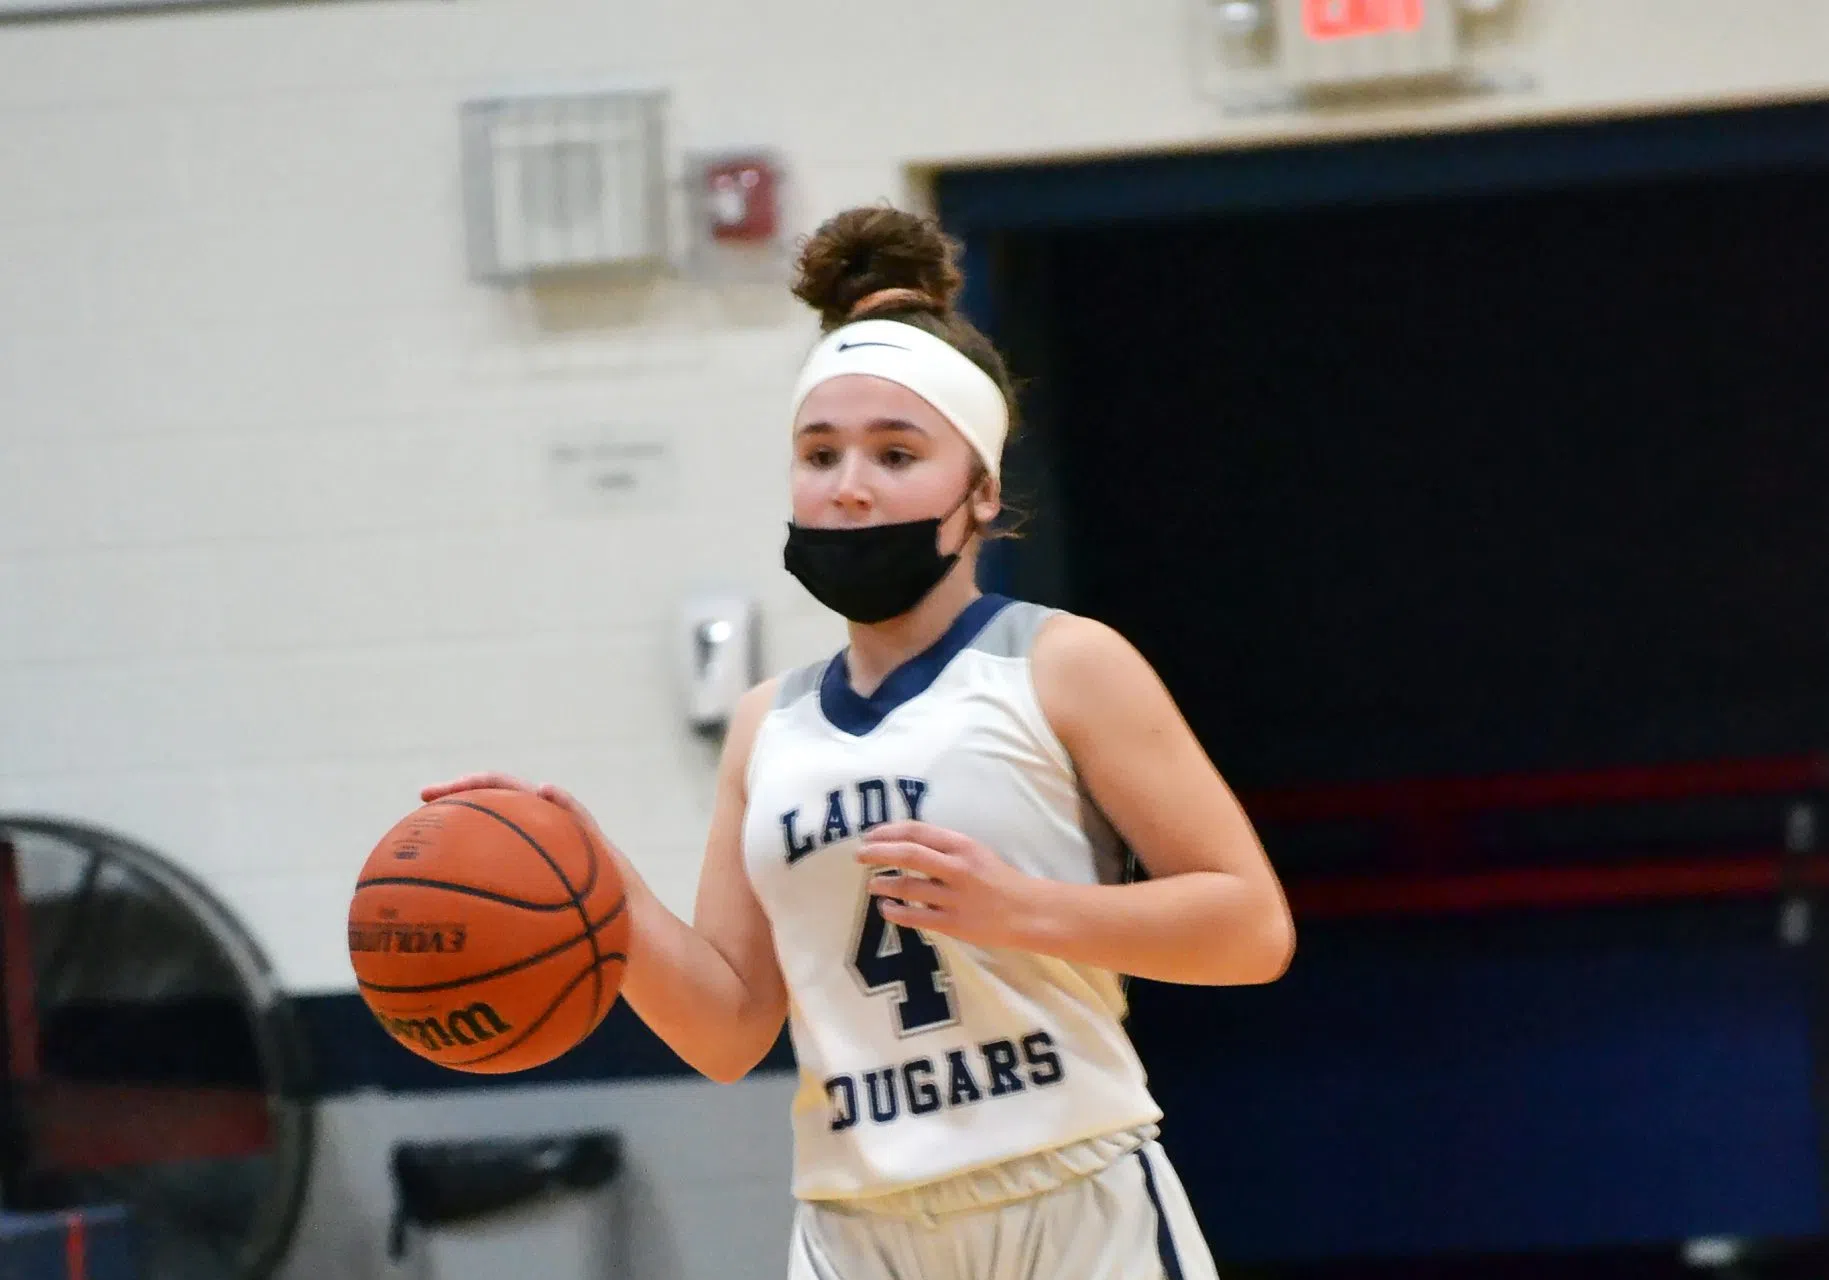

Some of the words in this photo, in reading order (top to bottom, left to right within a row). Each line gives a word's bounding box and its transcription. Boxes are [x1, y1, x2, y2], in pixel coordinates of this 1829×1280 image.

[780, 774, 929, 865] LADY
[845, 866, 961, 1040] 4
[823, 1030, 1066, 1132] OUGARS
